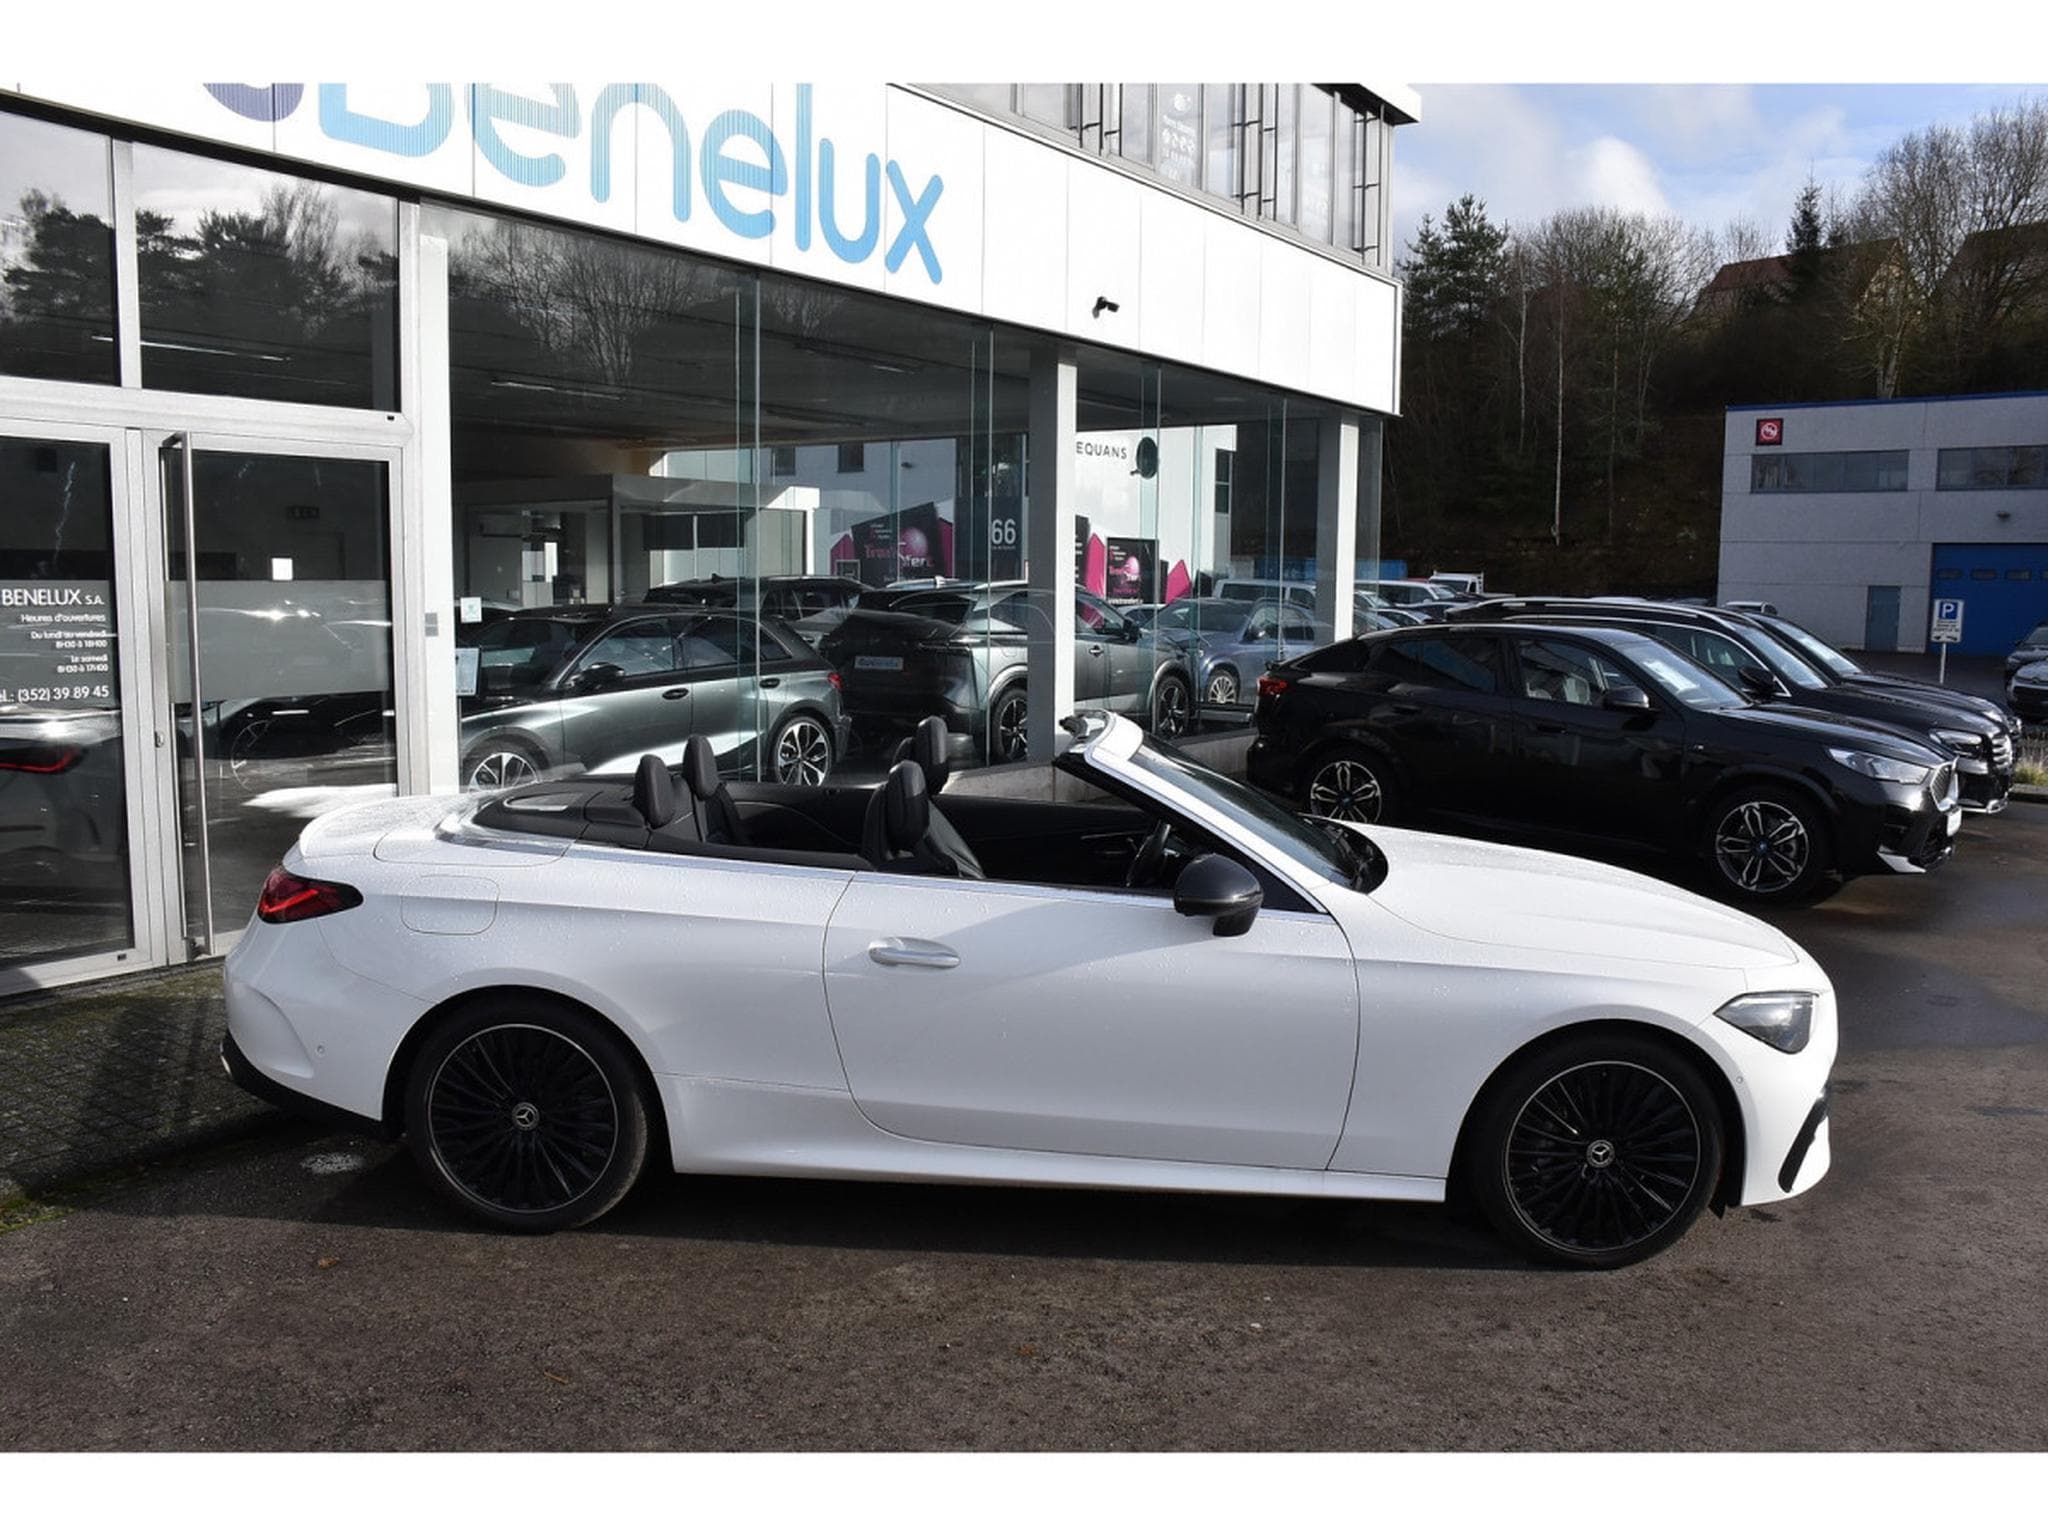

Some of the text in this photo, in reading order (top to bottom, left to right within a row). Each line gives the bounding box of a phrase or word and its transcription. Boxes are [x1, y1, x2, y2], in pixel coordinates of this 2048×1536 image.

[1076, 441, 1127, 460] EQUANS
[992, 518, 1017, 545] 66
[2, 588, 82, 606] BENELUX
[1942, 603, 1955, 618] P
[17, 688, 50, 703] (352)
[53, 687, 70, 700] 39
[73, 686, 90, 699] 89
[92, 685, 110, 698] 45
